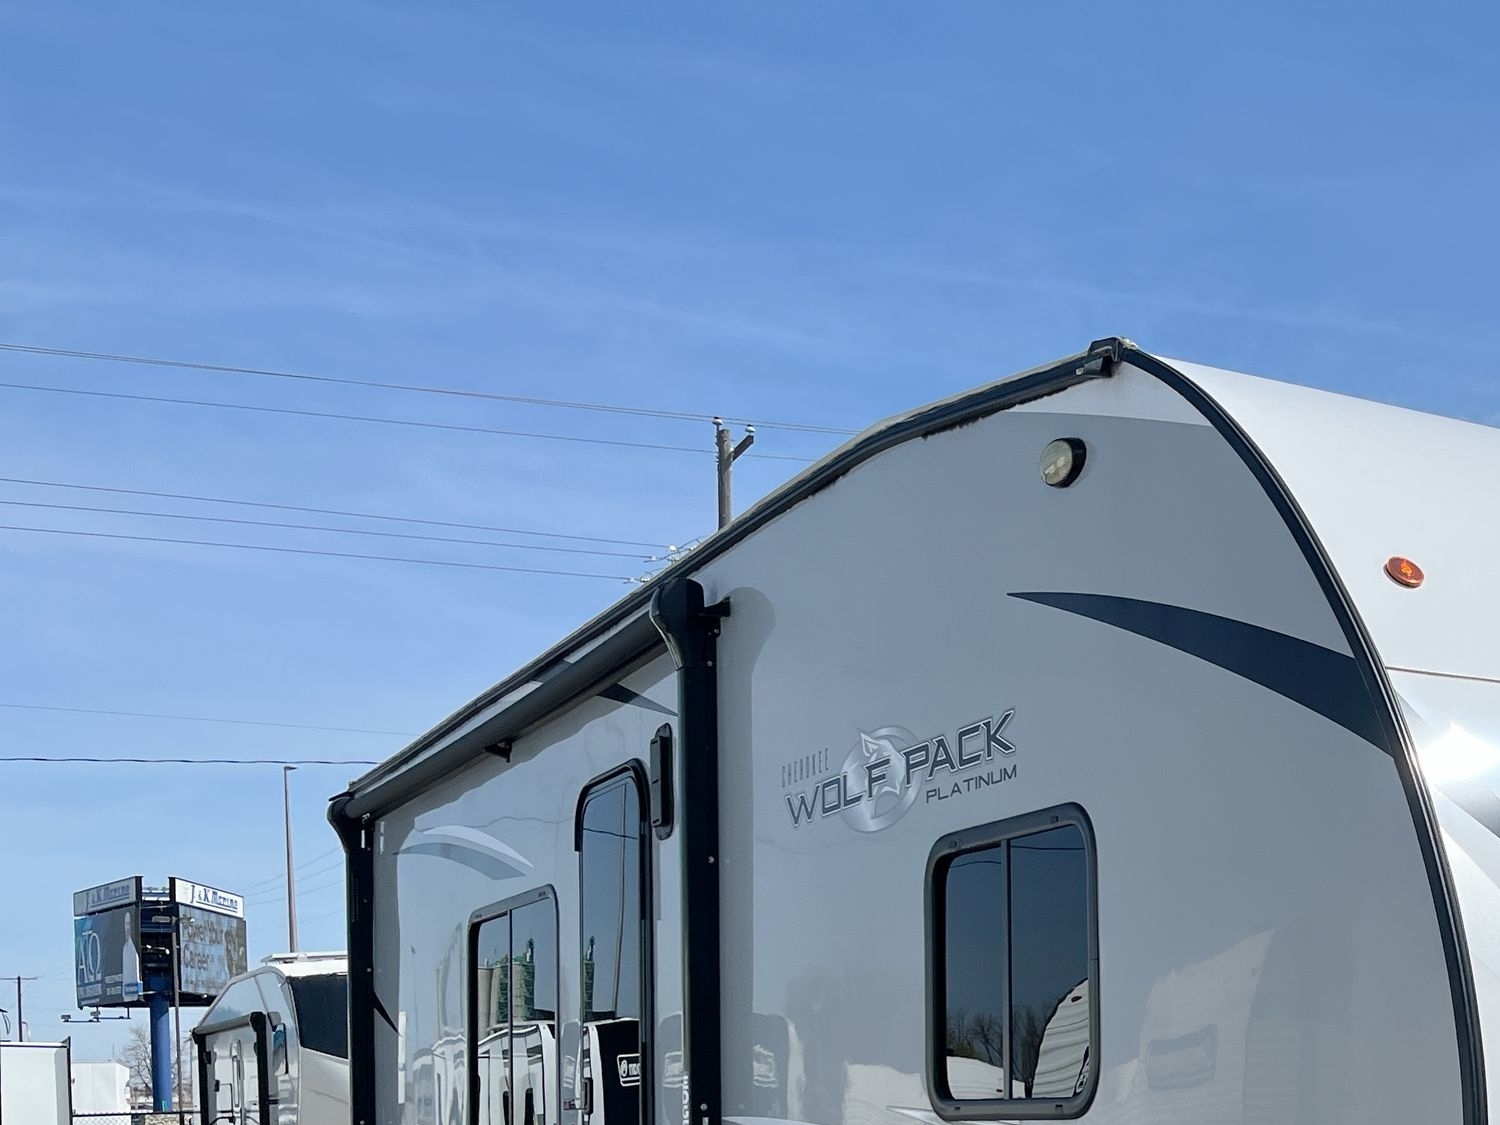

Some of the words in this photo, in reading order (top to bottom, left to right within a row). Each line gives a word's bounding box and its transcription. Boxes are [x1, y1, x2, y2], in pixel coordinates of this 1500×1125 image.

[781, 747, 830, 788] CHEROKEE
[785, 756, 891, 828] WOLF
[900, 707, 1016, 788] PACK
[926, 763, 1018, 804] PLATINUM
